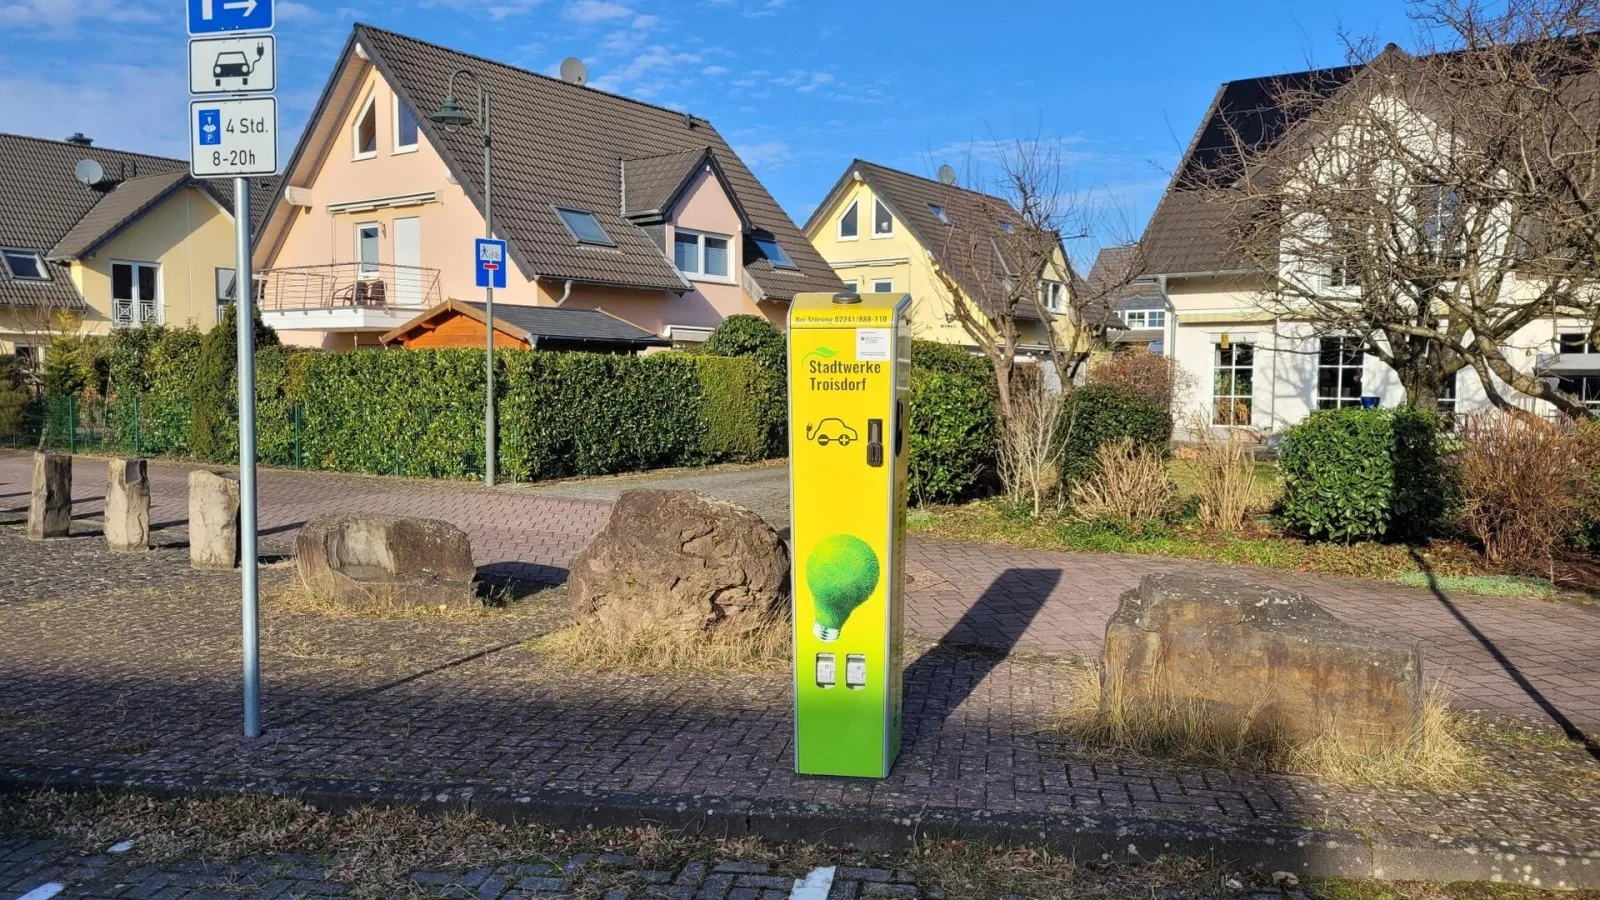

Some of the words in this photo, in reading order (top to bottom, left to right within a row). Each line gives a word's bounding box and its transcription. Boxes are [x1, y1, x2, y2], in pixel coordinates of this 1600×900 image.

[226, 118, 235, 134] 4
[239, 117, 268, 134] Std.
[207, 134, 213, 142] P
[212, 149, 256, 166] 8-20h
[834, 315, 887, 323] 02241/888-110
[809, 360, 881, 374] Stadtwerke
[809, 377, 867, 391] Troisdorf
